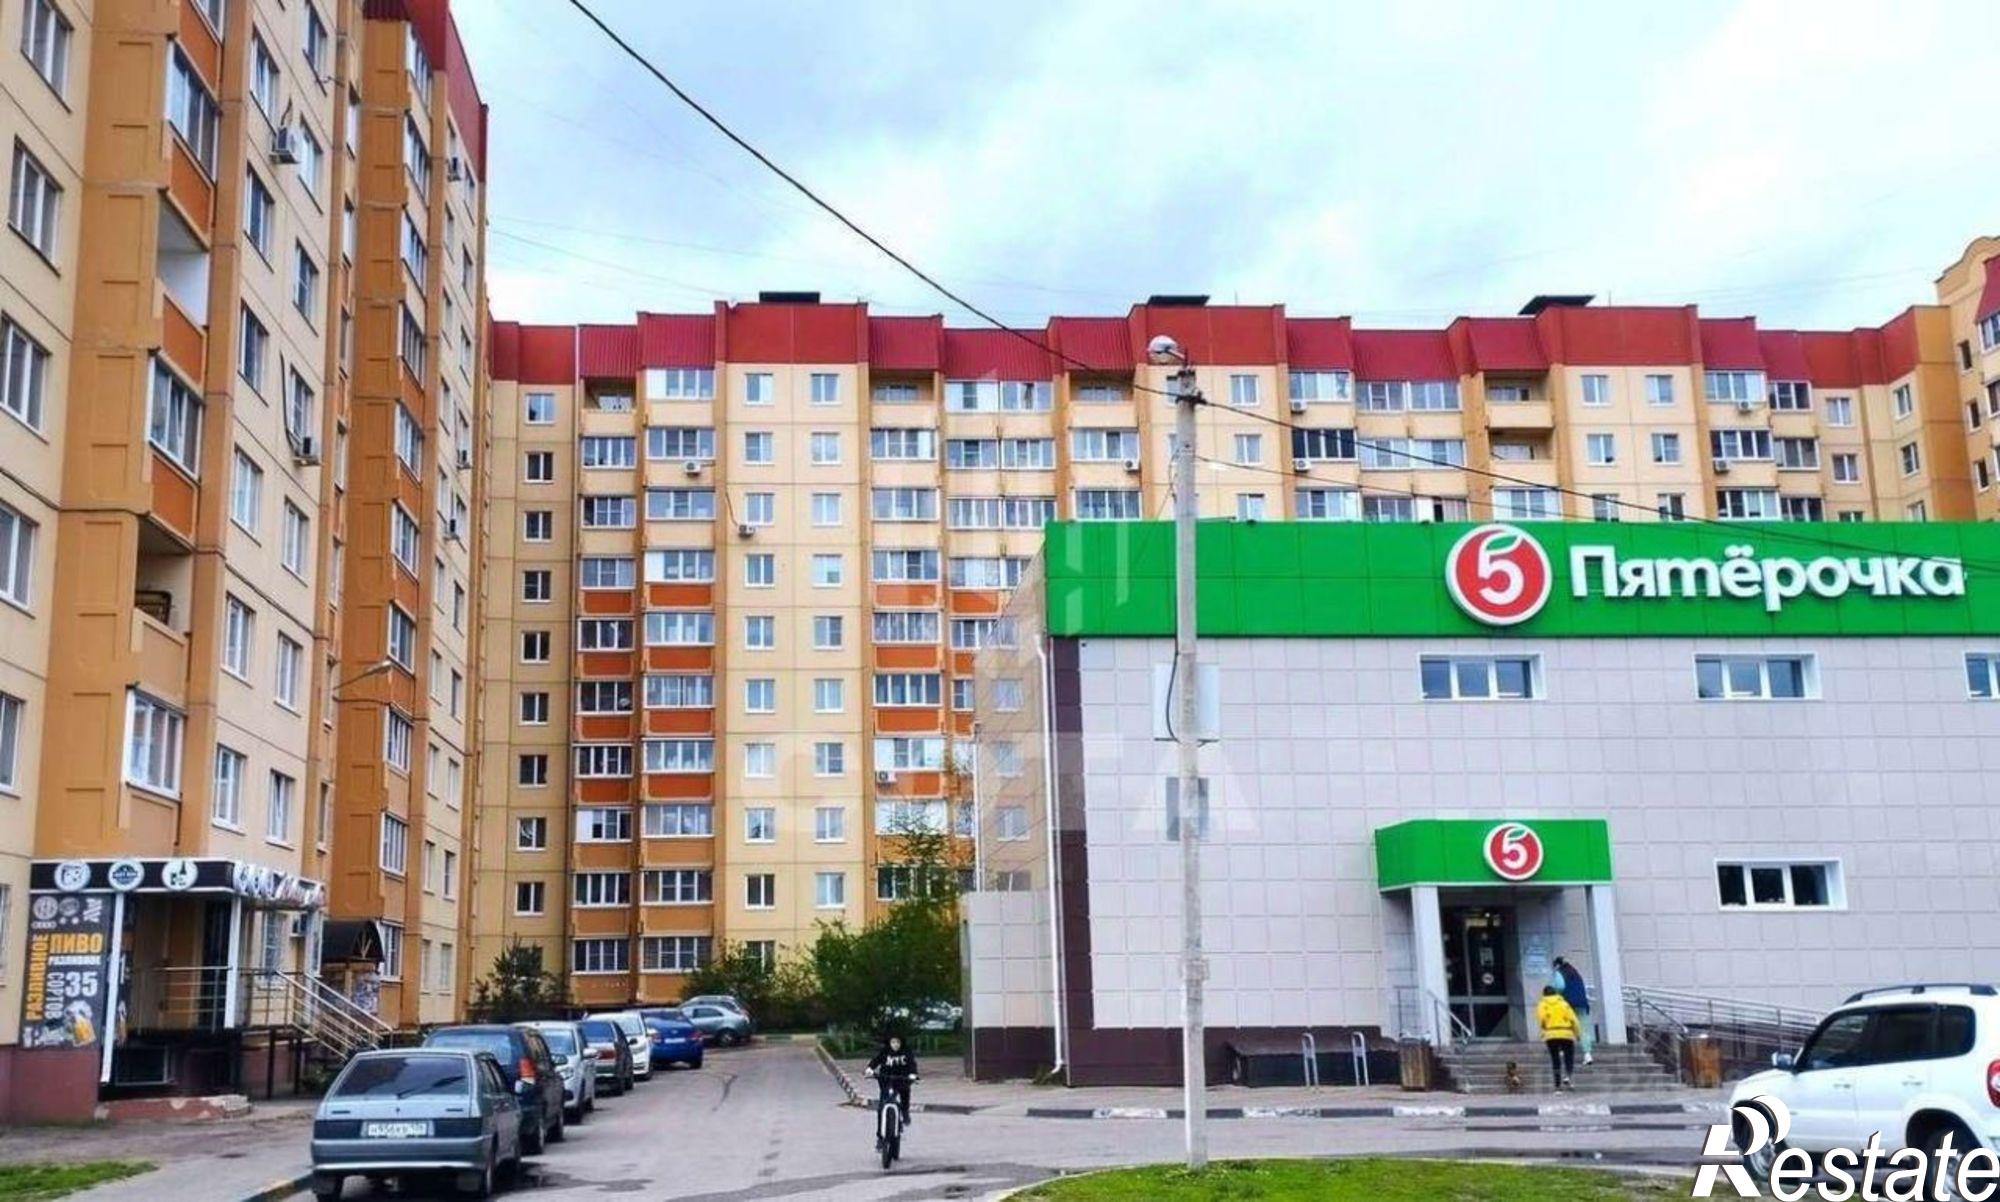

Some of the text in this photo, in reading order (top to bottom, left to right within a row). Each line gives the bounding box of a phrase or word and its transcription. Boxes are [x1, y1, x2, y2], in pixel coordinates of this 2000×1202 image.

[1569, 544, 1966, 612] Пятёрочка
[50, 933, 103, 954] ПИВО
[65, 971, 98, 997] 35
